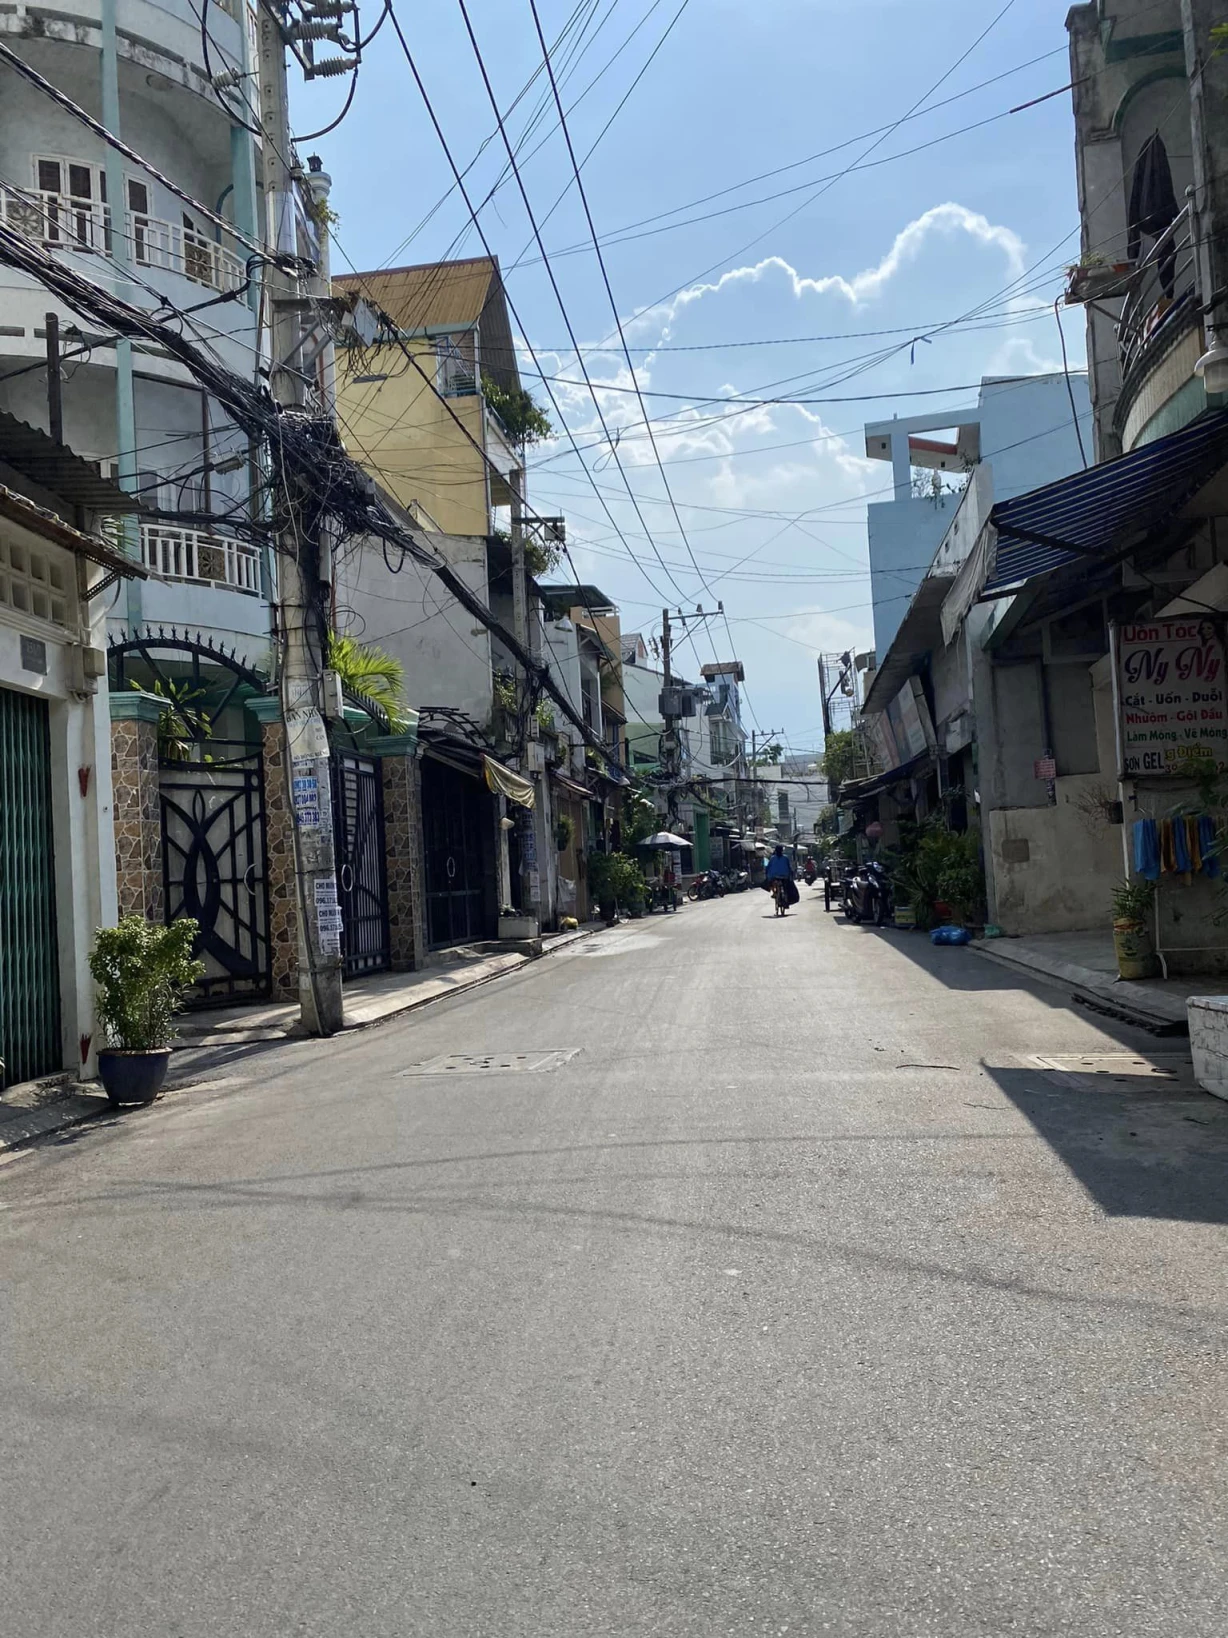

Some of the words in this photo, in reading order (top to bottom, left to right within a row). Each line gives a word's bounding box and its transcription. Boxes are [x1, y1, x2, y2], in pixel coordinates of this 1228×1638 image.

[1125, 648, 1169, 685] Ny
[1175, 645, 1220, 682] Ny
[1155, 691, 1182, 705] Uốn
[1143, 752, 1165, 770] GEL
